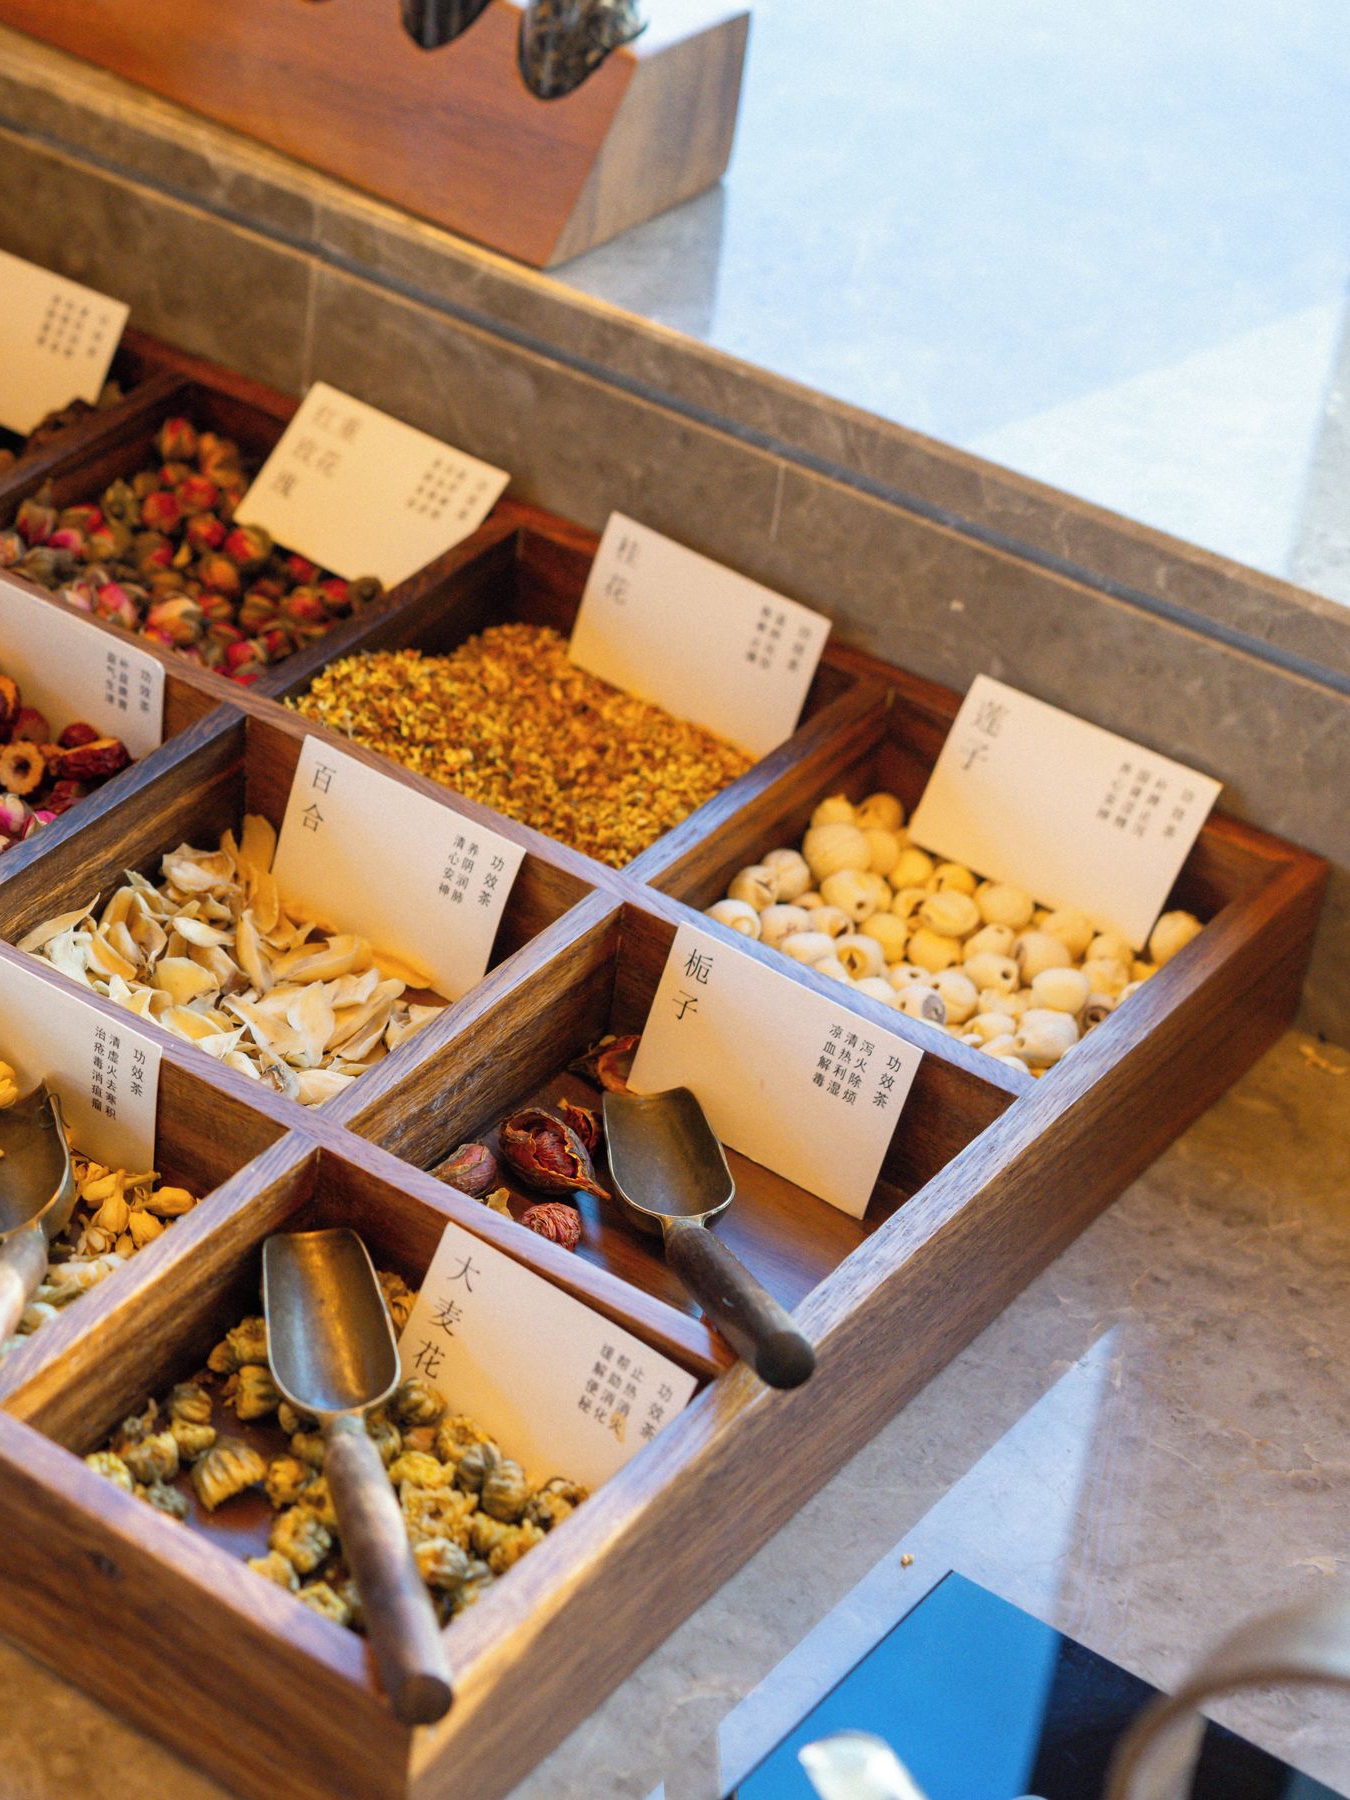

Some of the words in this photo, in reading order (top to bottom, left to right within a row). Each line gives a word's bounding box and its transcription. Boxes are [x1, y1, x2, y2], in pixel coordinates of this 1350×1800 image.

[302, 761, 337, 832] 百合
[438, 834, 466, 897] 清心安神
[450, 842, 479, 905] 养阴润肺
[478, 854, 505, 908] 功效茶
[671, 948, 714, 1020] 栀子
[105, 1033, 121, 1121] 清虚火去寒积
[131, 1047, 146, 1098] 功效茶
[812, 1023, 843, 1089] 凉血解毒
[826, 1031, 858, 1099] 清热利湿
[842, 1039, 875, 1106] 泻火除烦
[872, 1055, 902, 1109] 功效茶
[412, 1255, 480, 1379] 大麦花
[577, 1343, 615, 1413] 缓解便秘
[592, 1354, 632, 1425] 帮助消化
[608, 1366, 645, 1434] 止热消火
[639, 1383, 674, 1440] 功效茶
